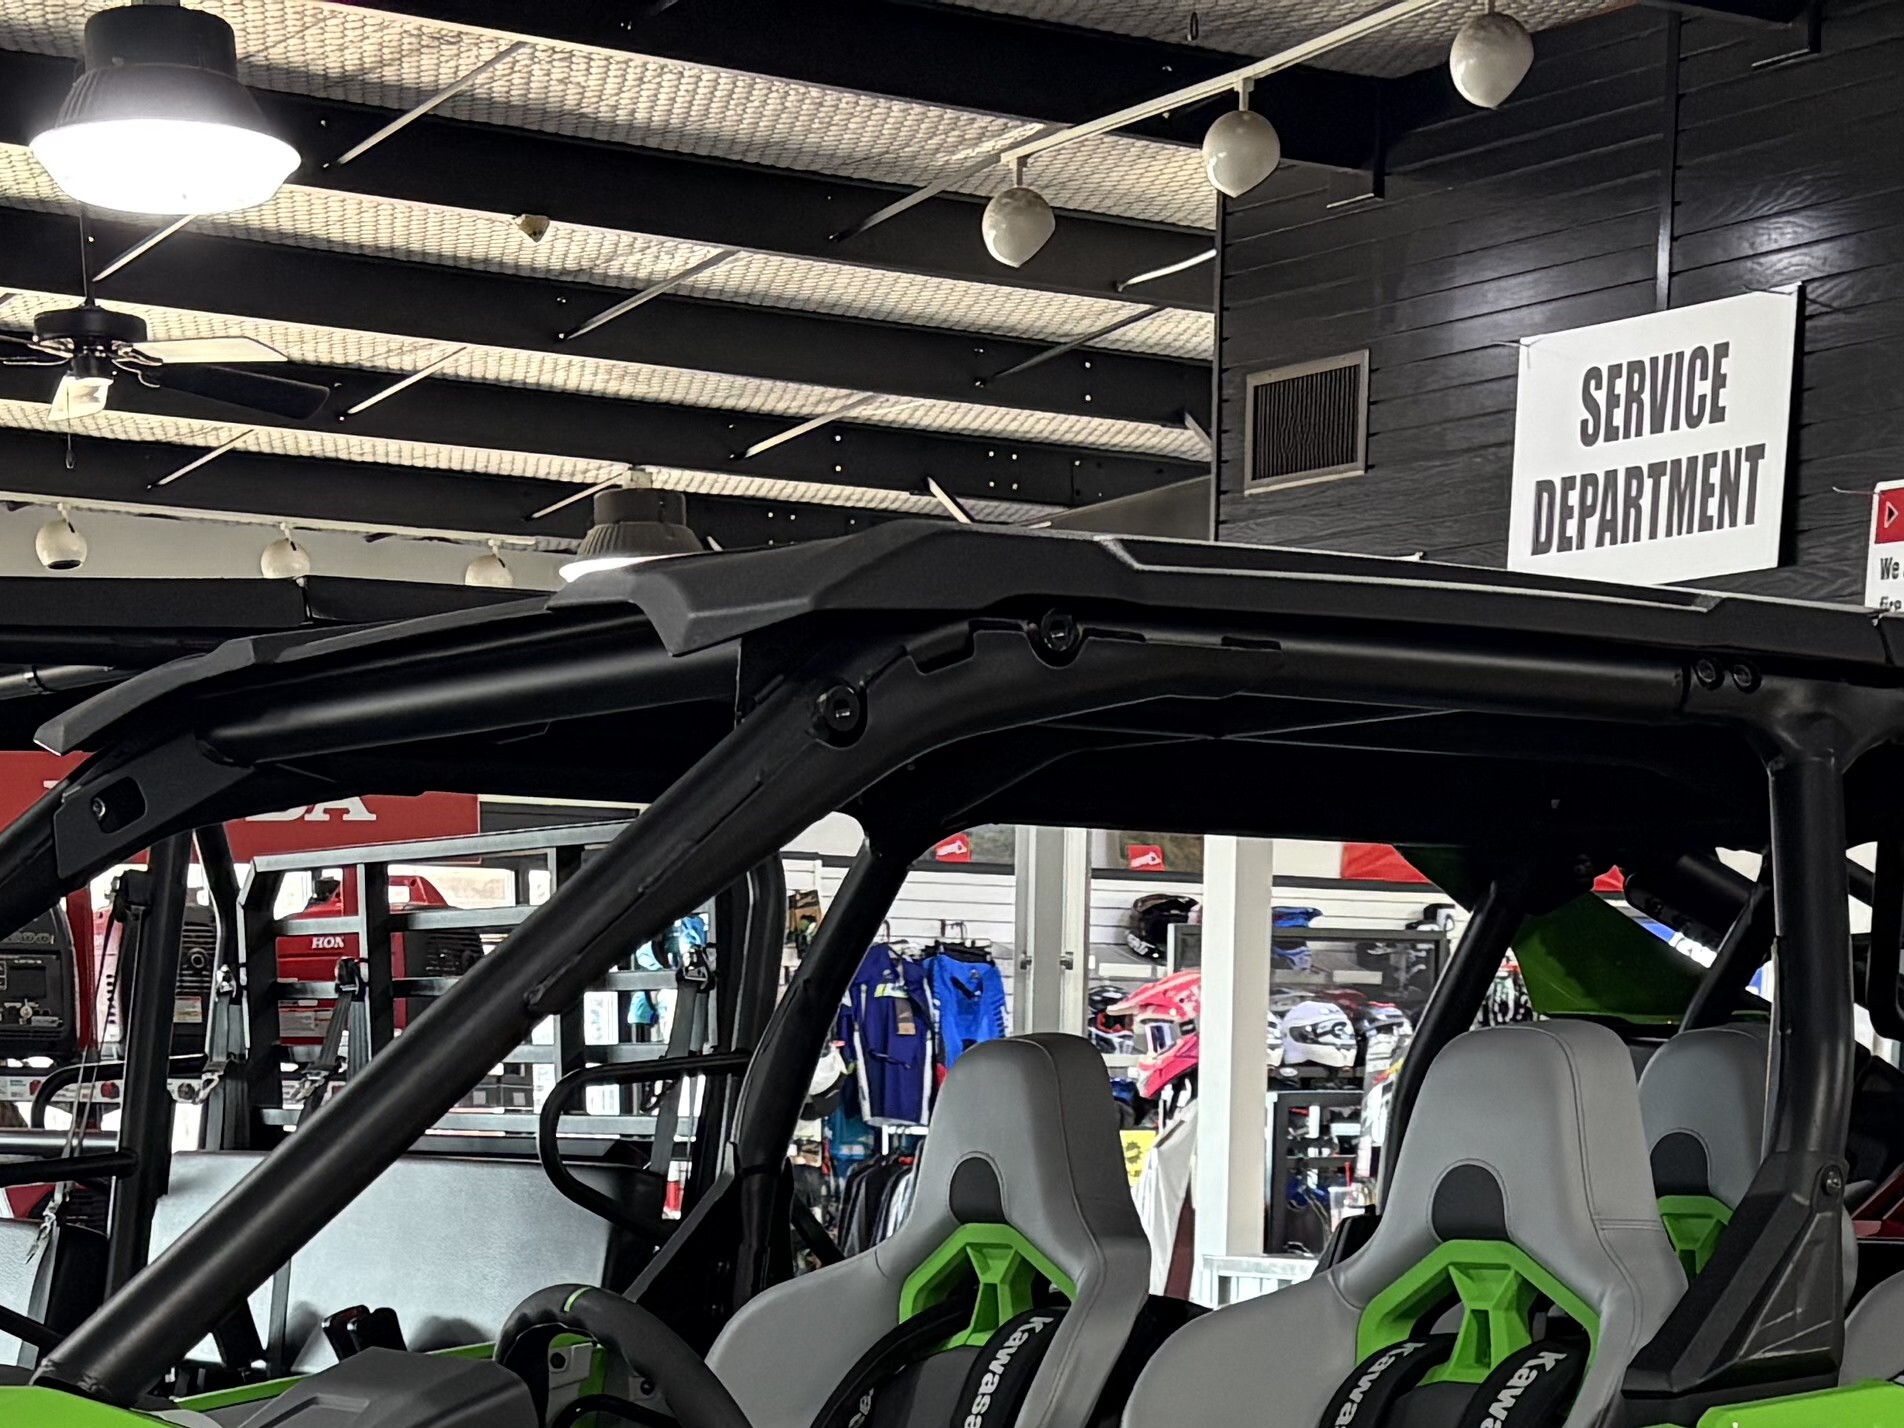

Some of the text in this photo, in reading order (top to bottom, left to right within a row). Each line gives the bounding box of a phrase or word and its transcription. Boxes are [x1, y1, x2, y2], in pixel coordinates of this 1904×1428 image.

[1579, 341, 1731, 447] SERVICE
[1530, 442, 1767, 556] DEPARTMENT
[1879, 556, 1900, 581] We
[311, 936, 345, 949] HON
